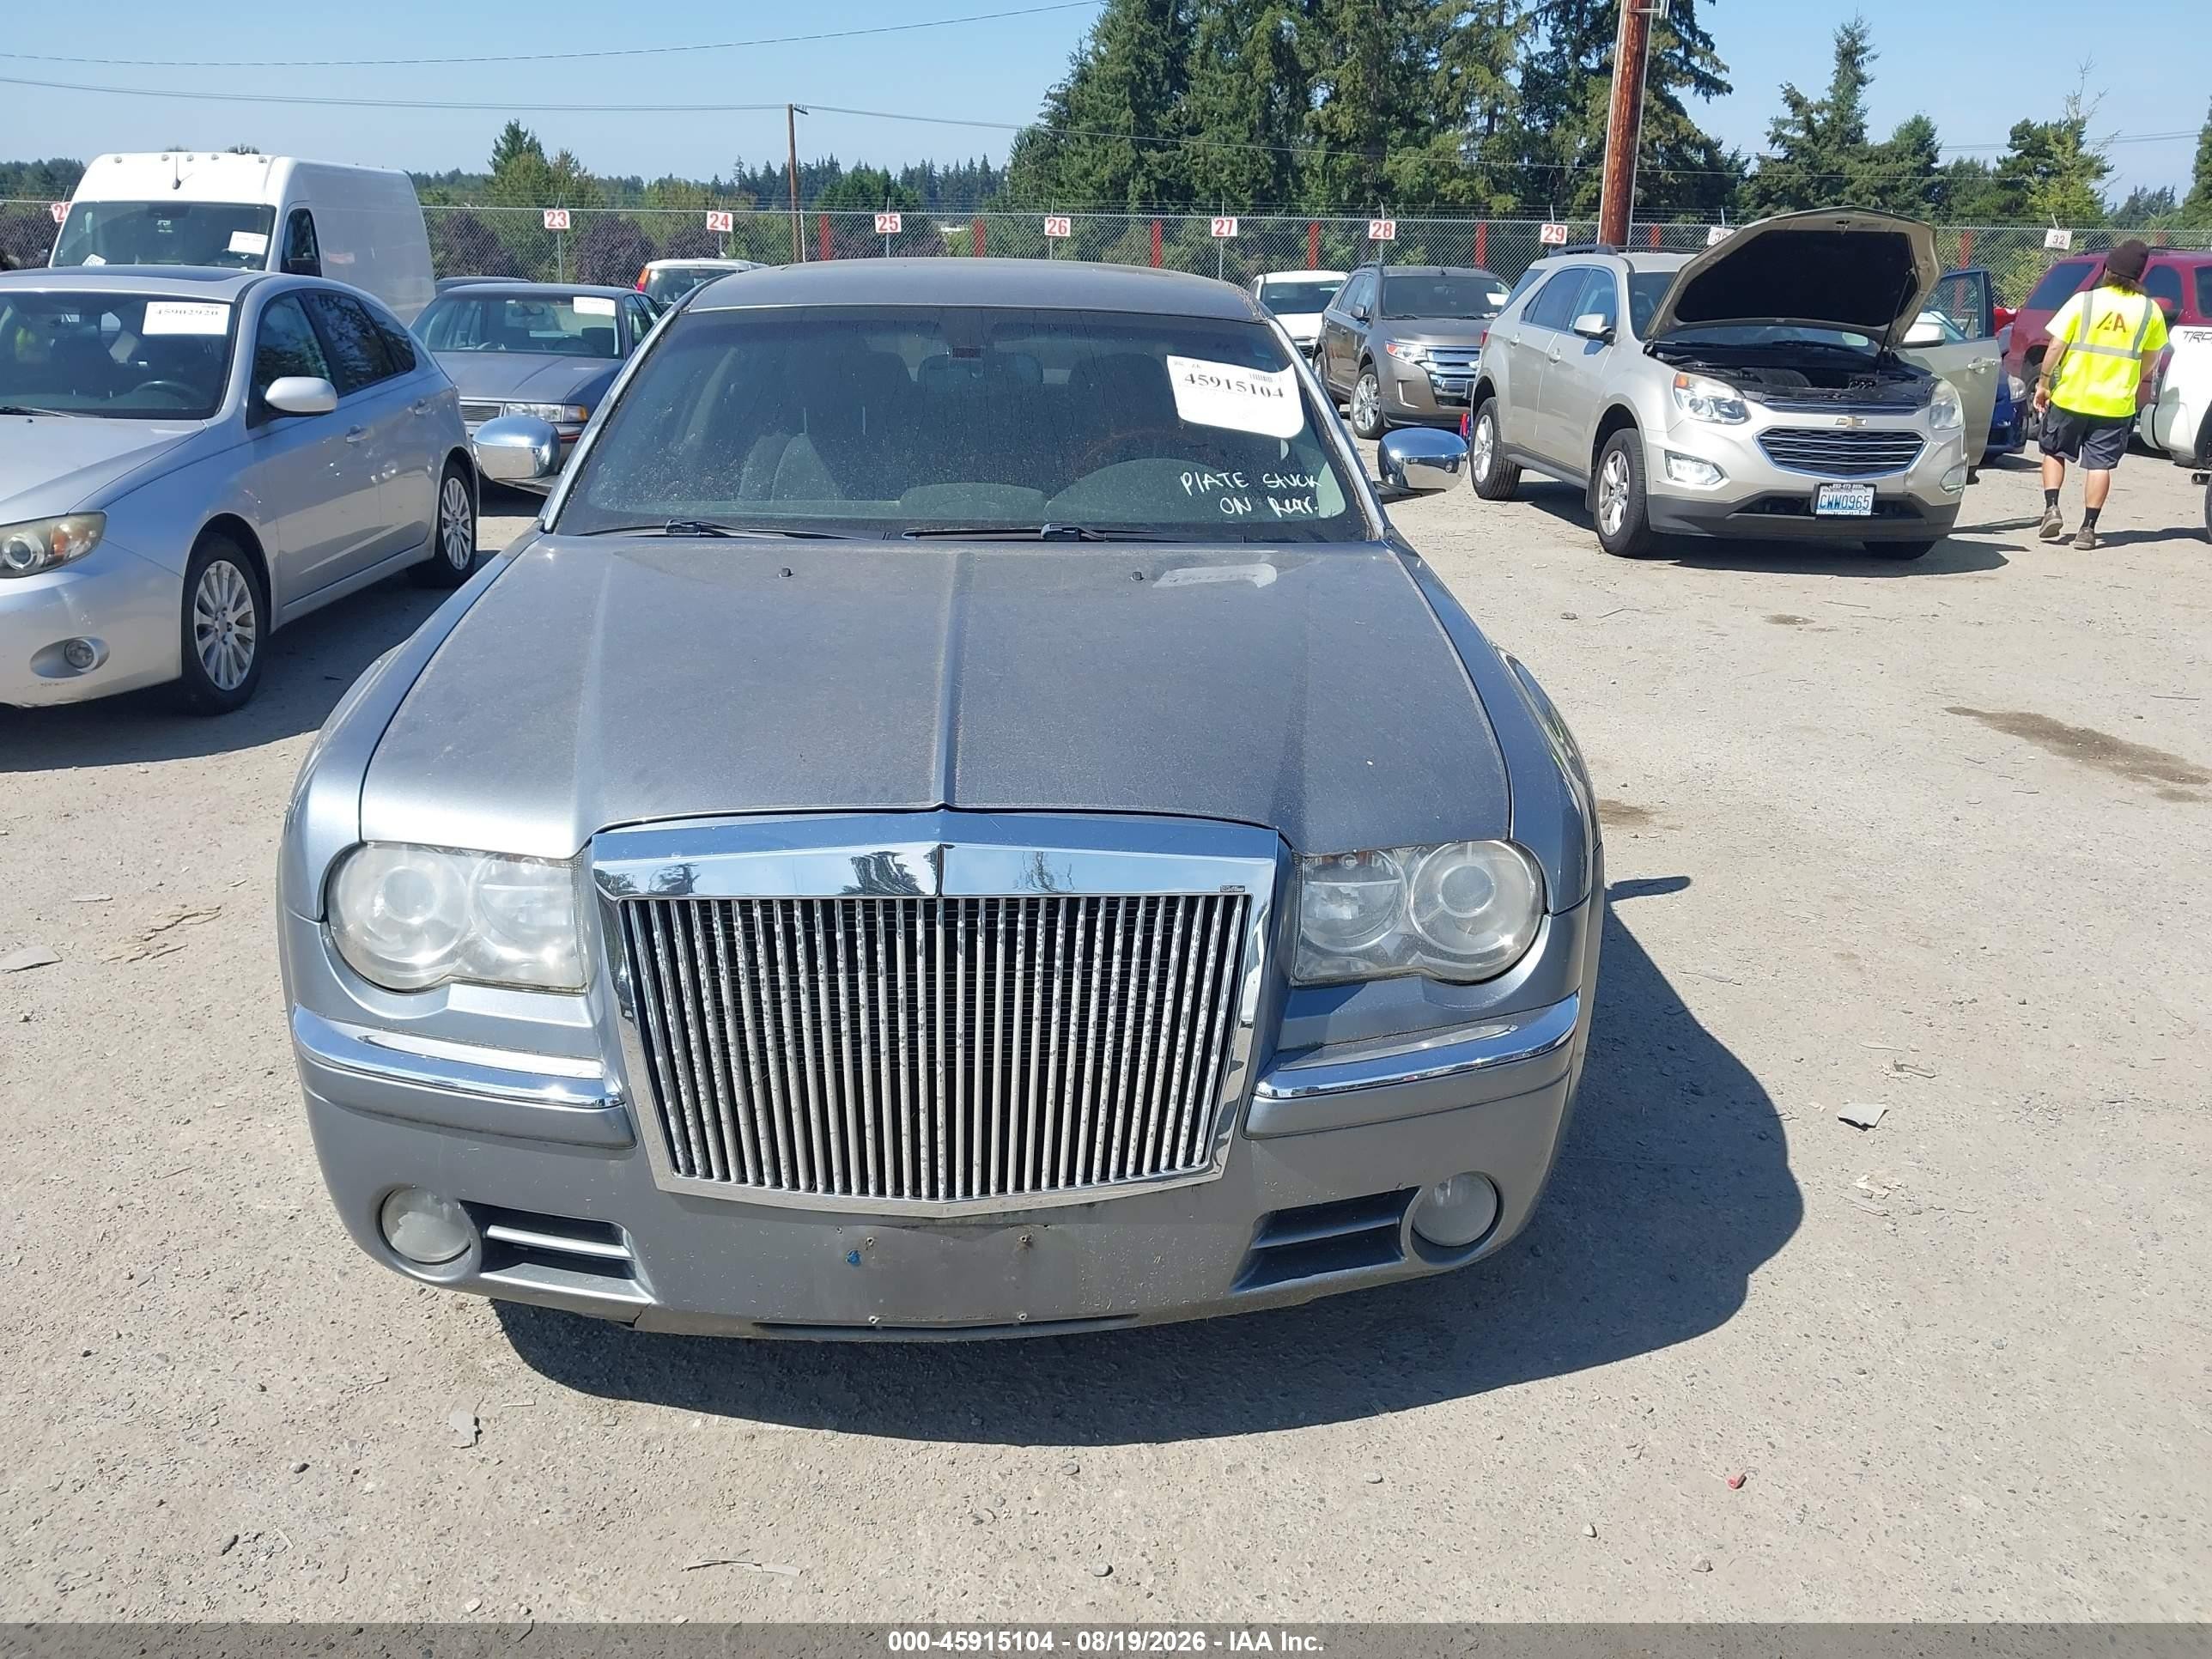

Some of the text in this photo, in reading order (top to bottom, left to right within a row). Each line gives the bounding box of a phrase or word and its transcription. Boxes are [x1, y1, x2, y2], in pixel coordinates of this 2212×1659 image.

[547, 211, 567, 227] 23
[709, 214, 730, 229] 24
[878, 216, 898, 231] 25
[1048, 219, 1067, 234] 26
[1215, 219, 1233, 235] 27
[1372, 222, 1392, 238] 28
[1544, 226, 1565, 241] 29
[2052, 234, 2065, 245] 32
[1184, 373, 1285, 398] 45915104
[1219, 496, 1252, 515] ON
[1820, 494, 1871, 509] CWW0965
